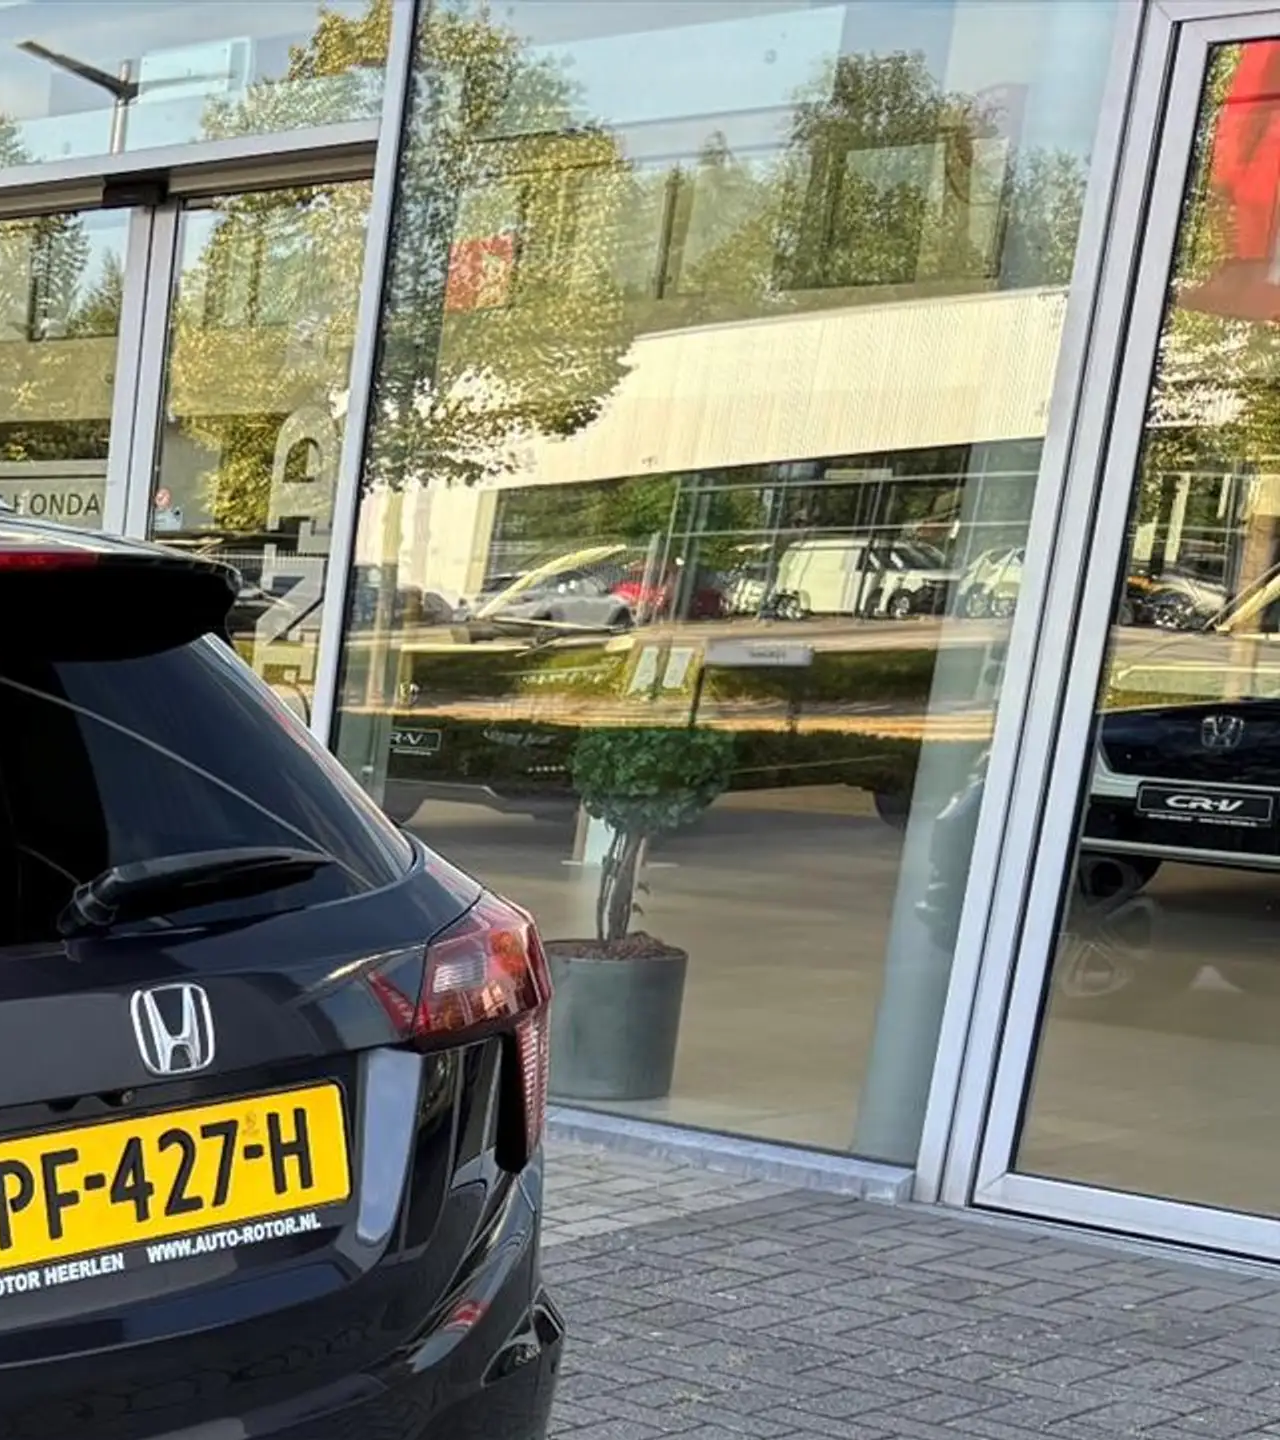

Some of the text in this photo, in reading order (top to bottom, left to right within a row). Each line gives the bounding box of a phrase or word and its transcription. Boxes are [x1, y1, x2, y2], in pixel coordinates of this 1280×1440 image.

[1165, 794, 1244, 812] CR-V
[44, 1252, 125, 1288] HEERLEN
[146, 1211, 322, 1264] WWW.AUTO-ROTOR.NL
